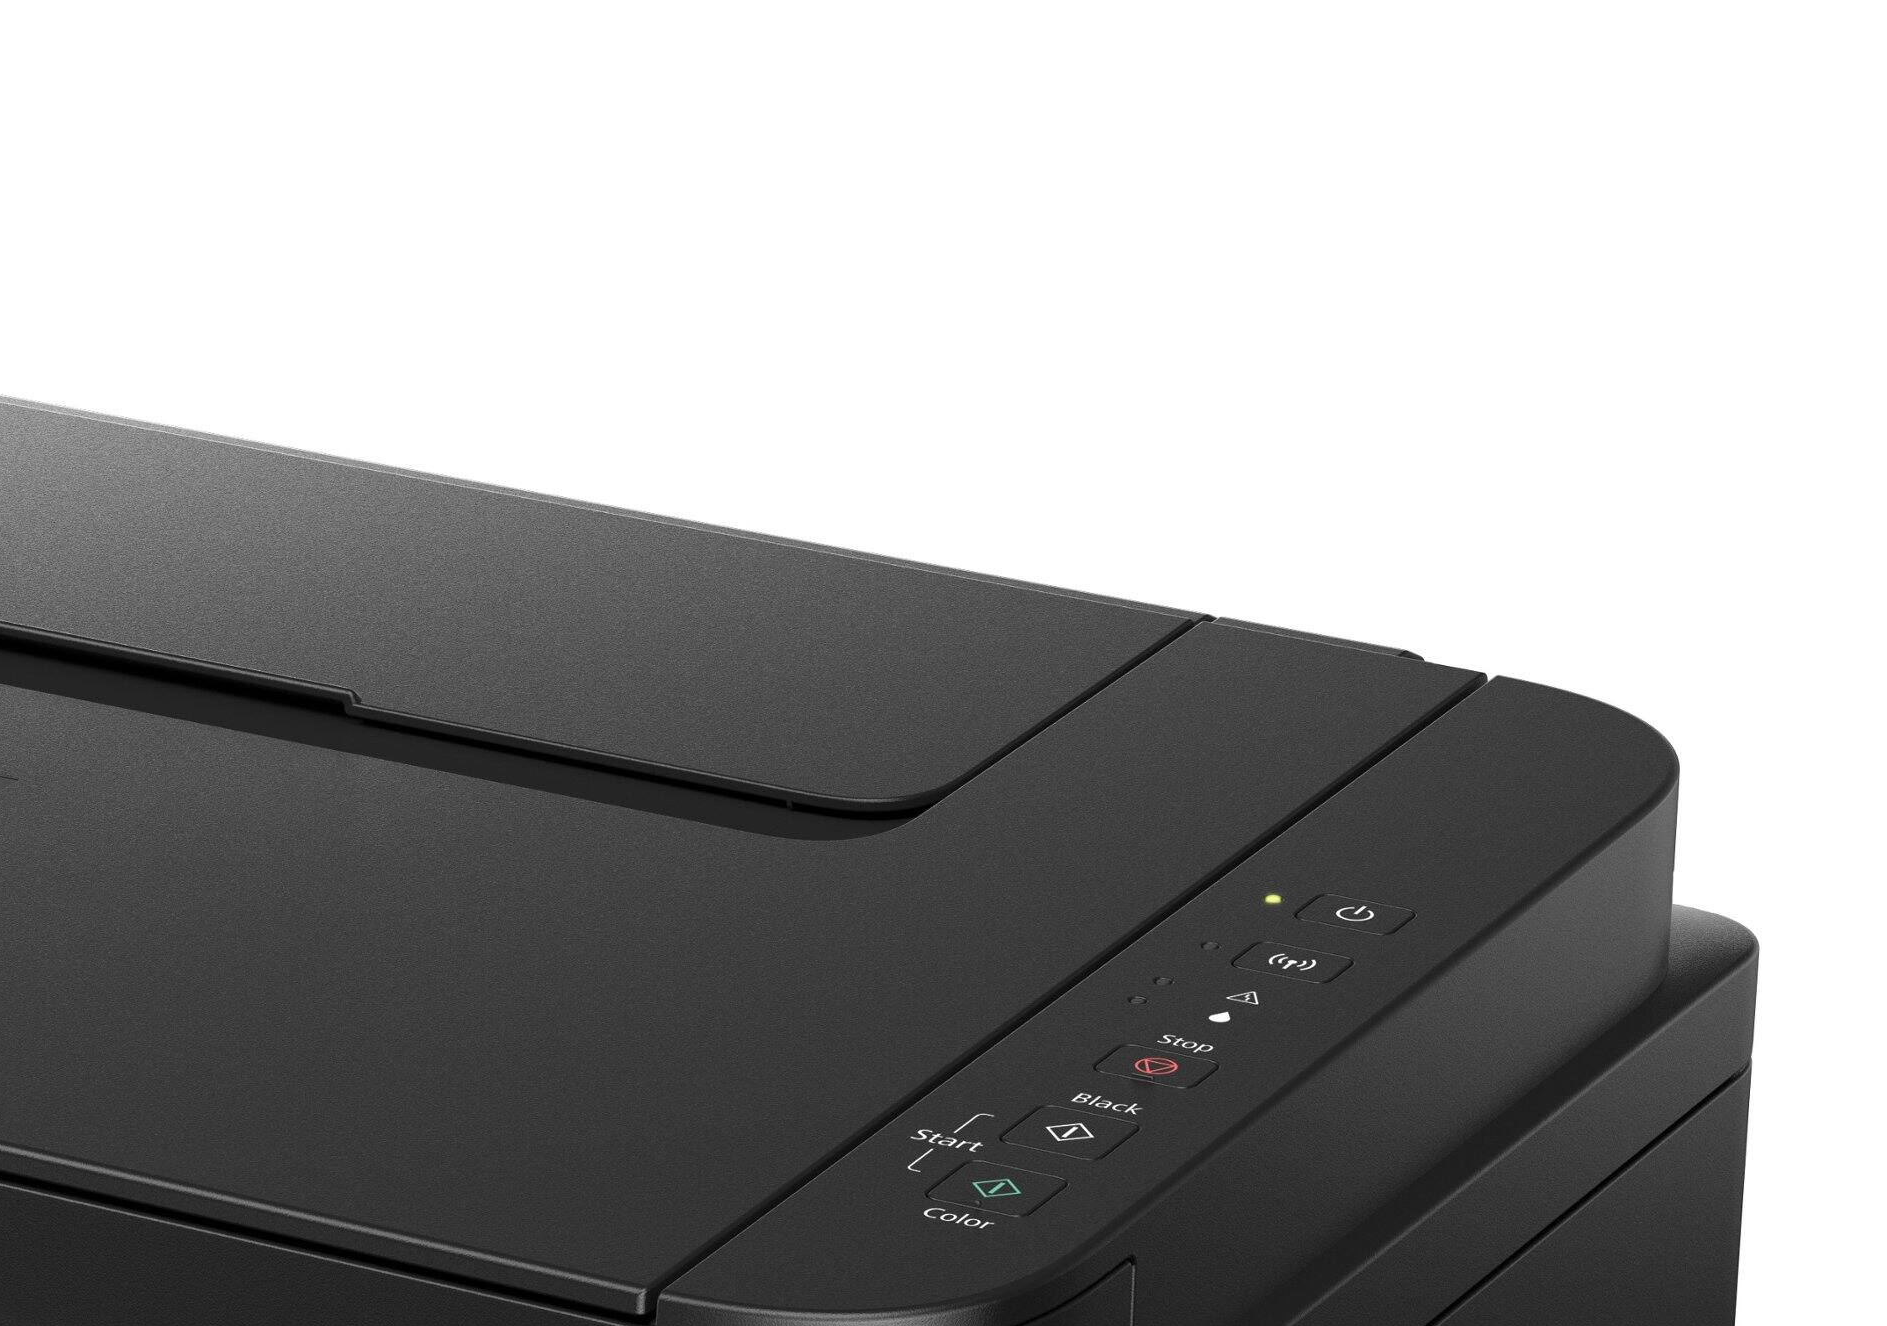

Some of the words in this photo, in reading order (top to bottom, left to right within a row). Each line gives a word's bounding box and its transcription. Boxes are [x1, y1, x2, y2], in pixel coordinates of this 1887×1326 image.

[1156, 1034, 1214, 1053] Stop
[1070, 1092, 1143, 1115] Black
[910, 1128, 984, 1153] Start
[923, 1207, 995, 1230] Color
